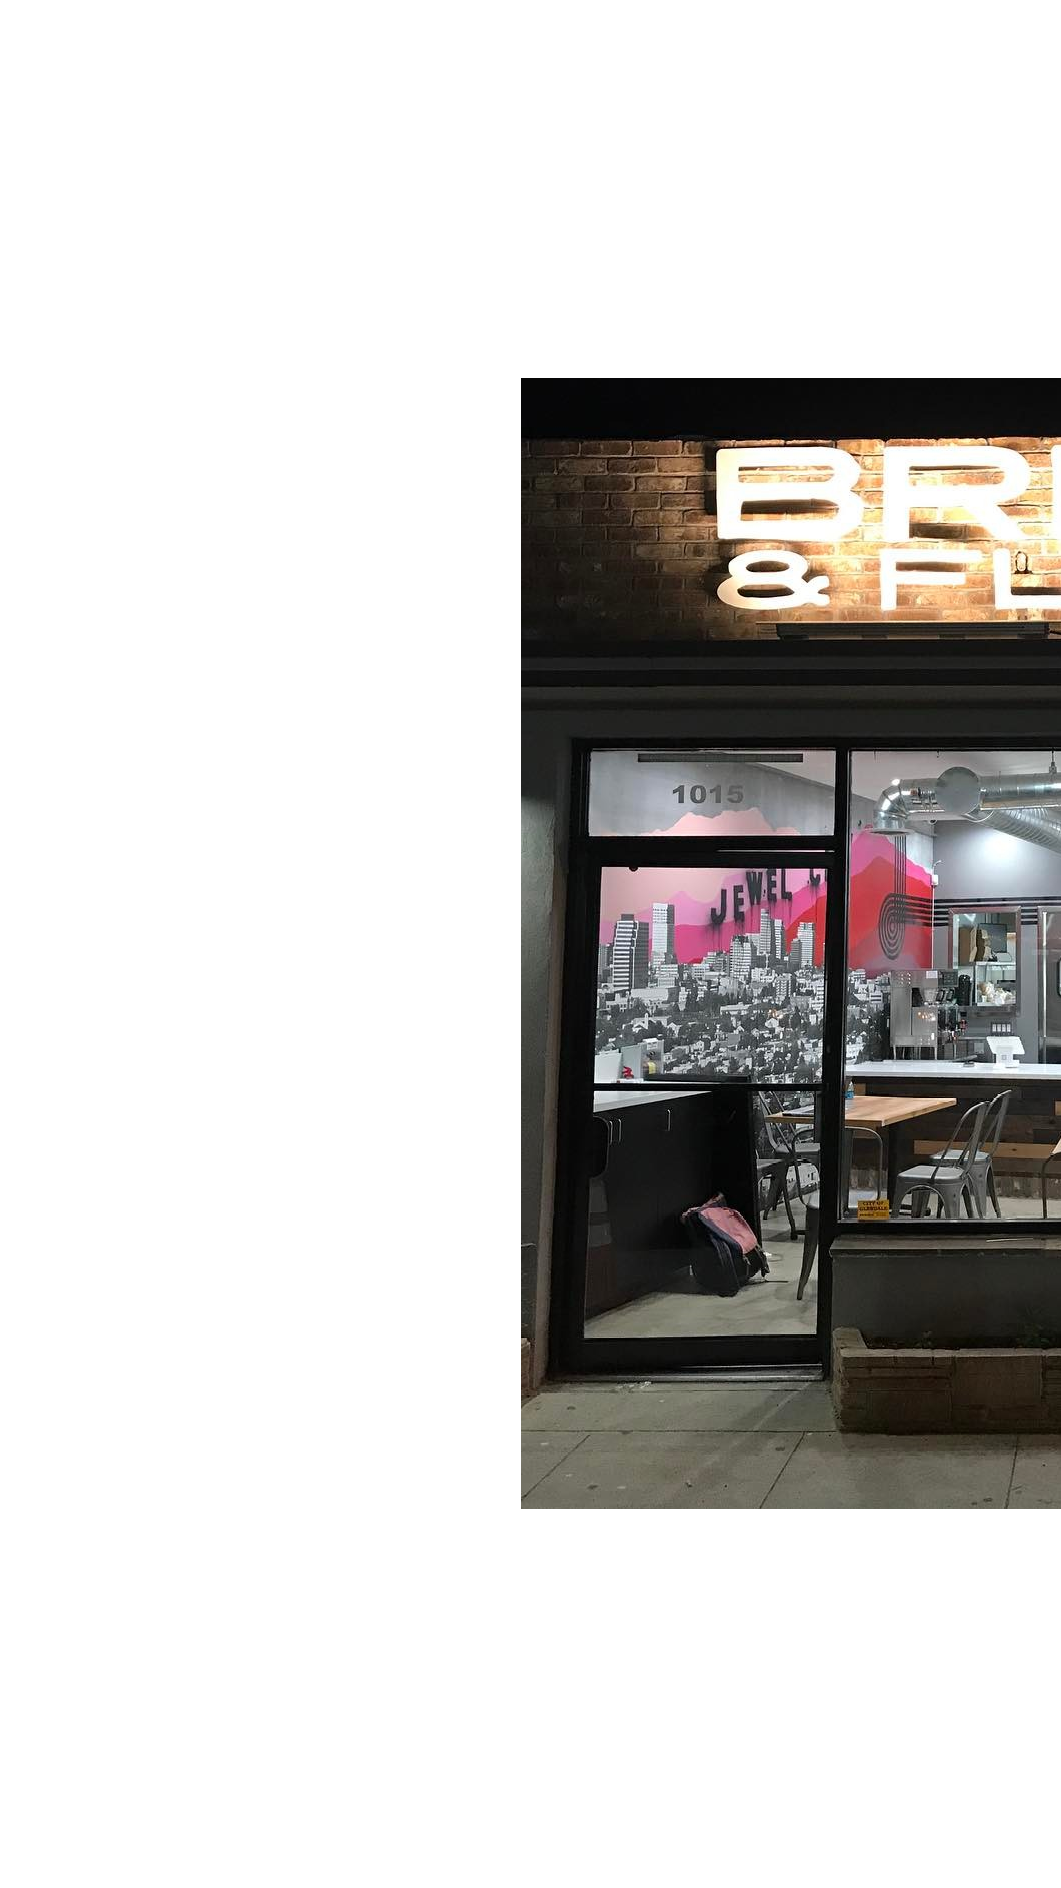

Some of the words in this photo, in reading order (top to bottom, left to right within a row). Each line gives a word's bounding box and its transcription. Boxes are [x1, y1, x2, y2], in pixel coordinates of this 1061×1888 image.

[716, 547, 831, 611] &
[672, 784, 744, 804] 1015
[710, 869, 793, 924] JEWEL
